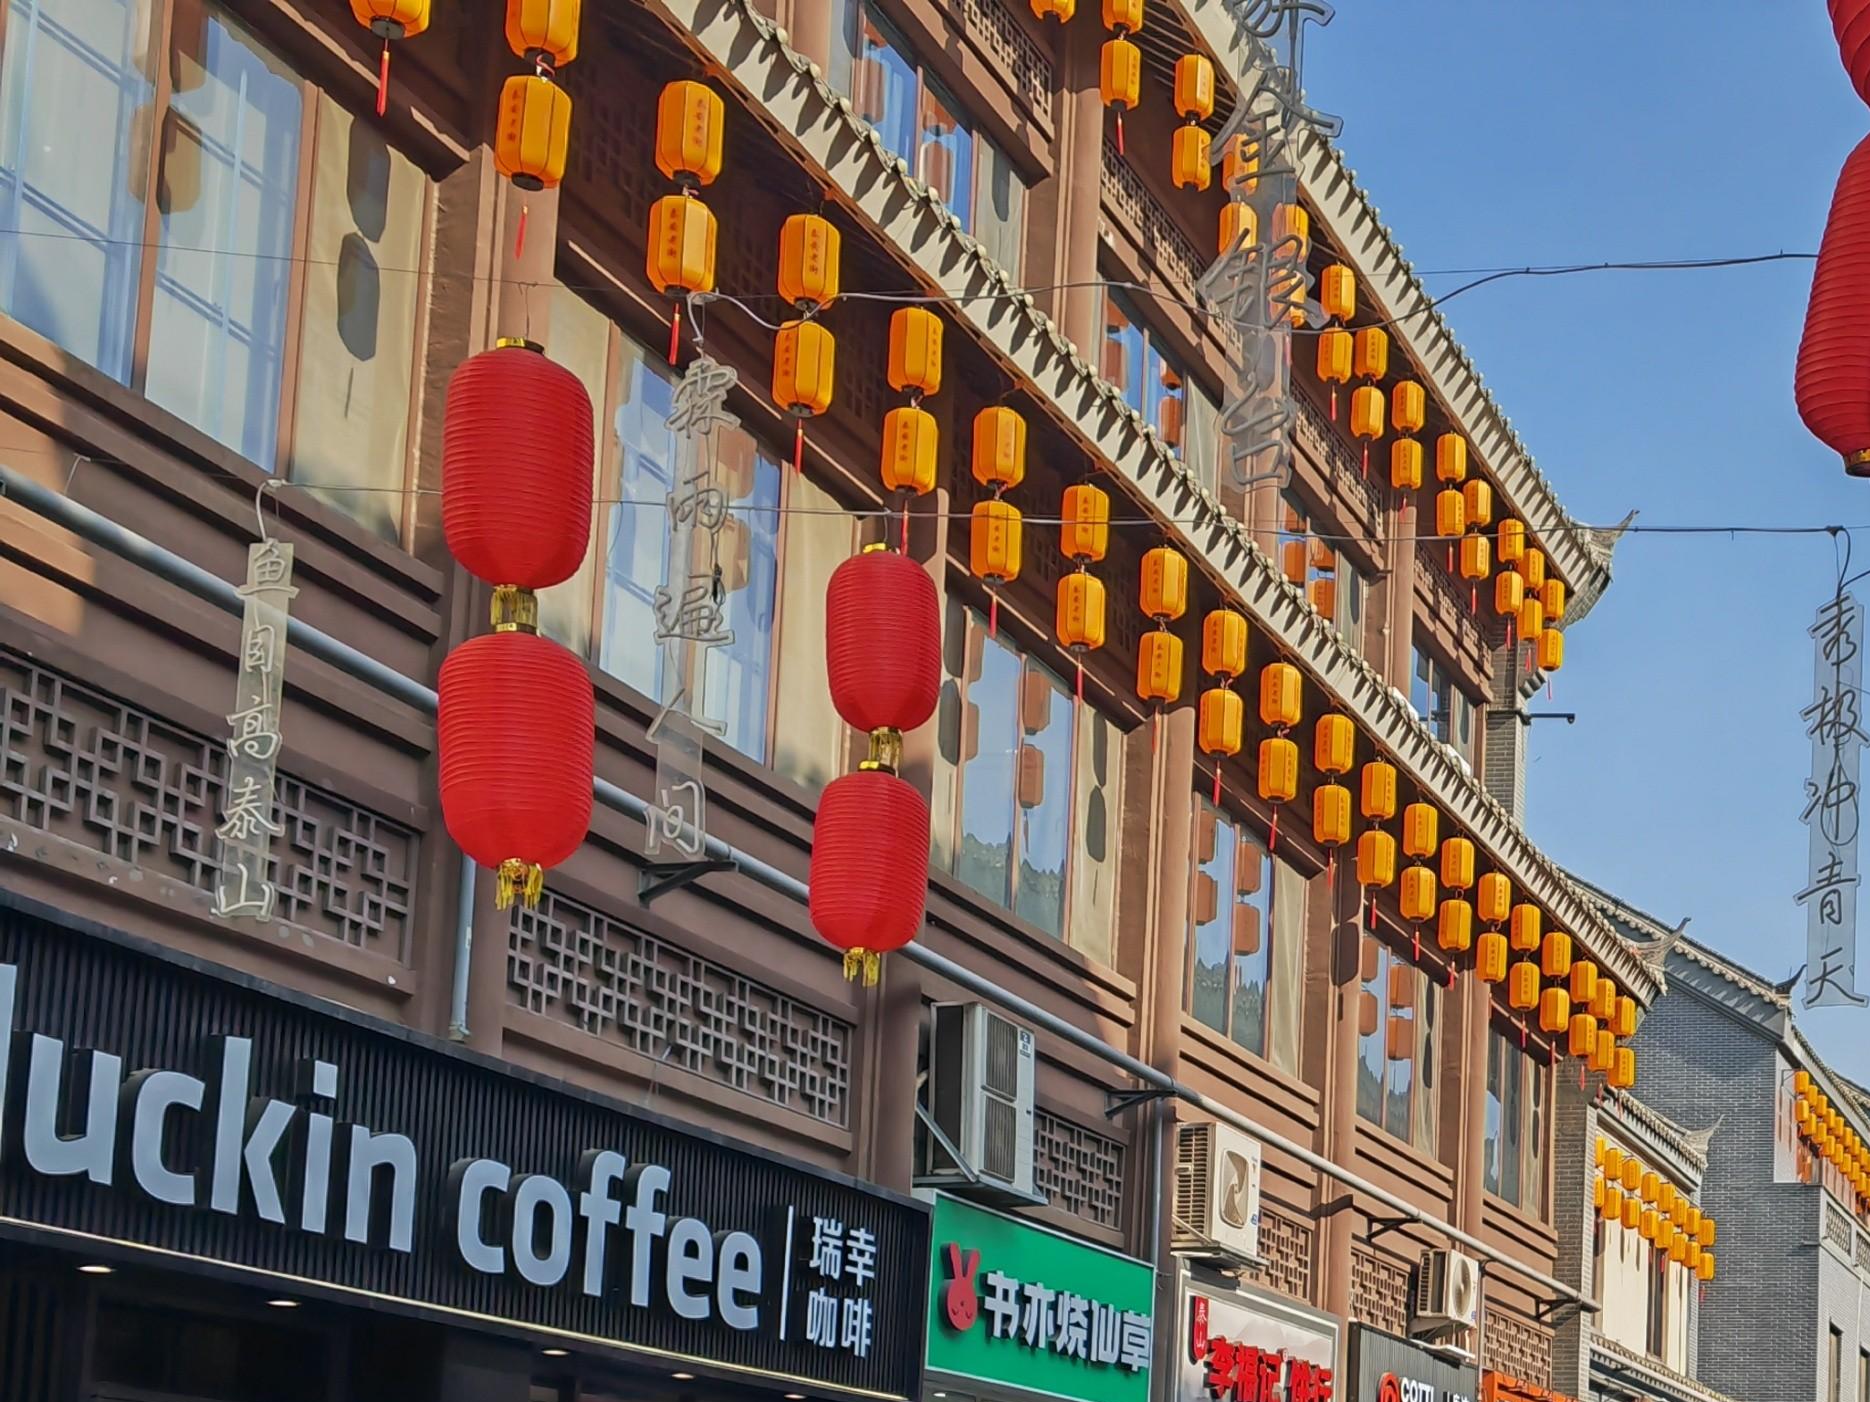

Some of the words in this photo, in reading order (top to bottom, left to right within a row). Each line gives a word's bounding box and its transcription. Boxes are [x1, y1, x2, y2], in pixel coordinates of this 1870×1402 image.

[1199, 0, 1334, 484] 金银台
[458, 1150, 763, 1331] coffee
[809, 1217, 877, 1288] 瑞幸
[806, 1288, 874, 1358] 咖啡
[984, 1270, 1152, 1373] 书亦烧仙草
